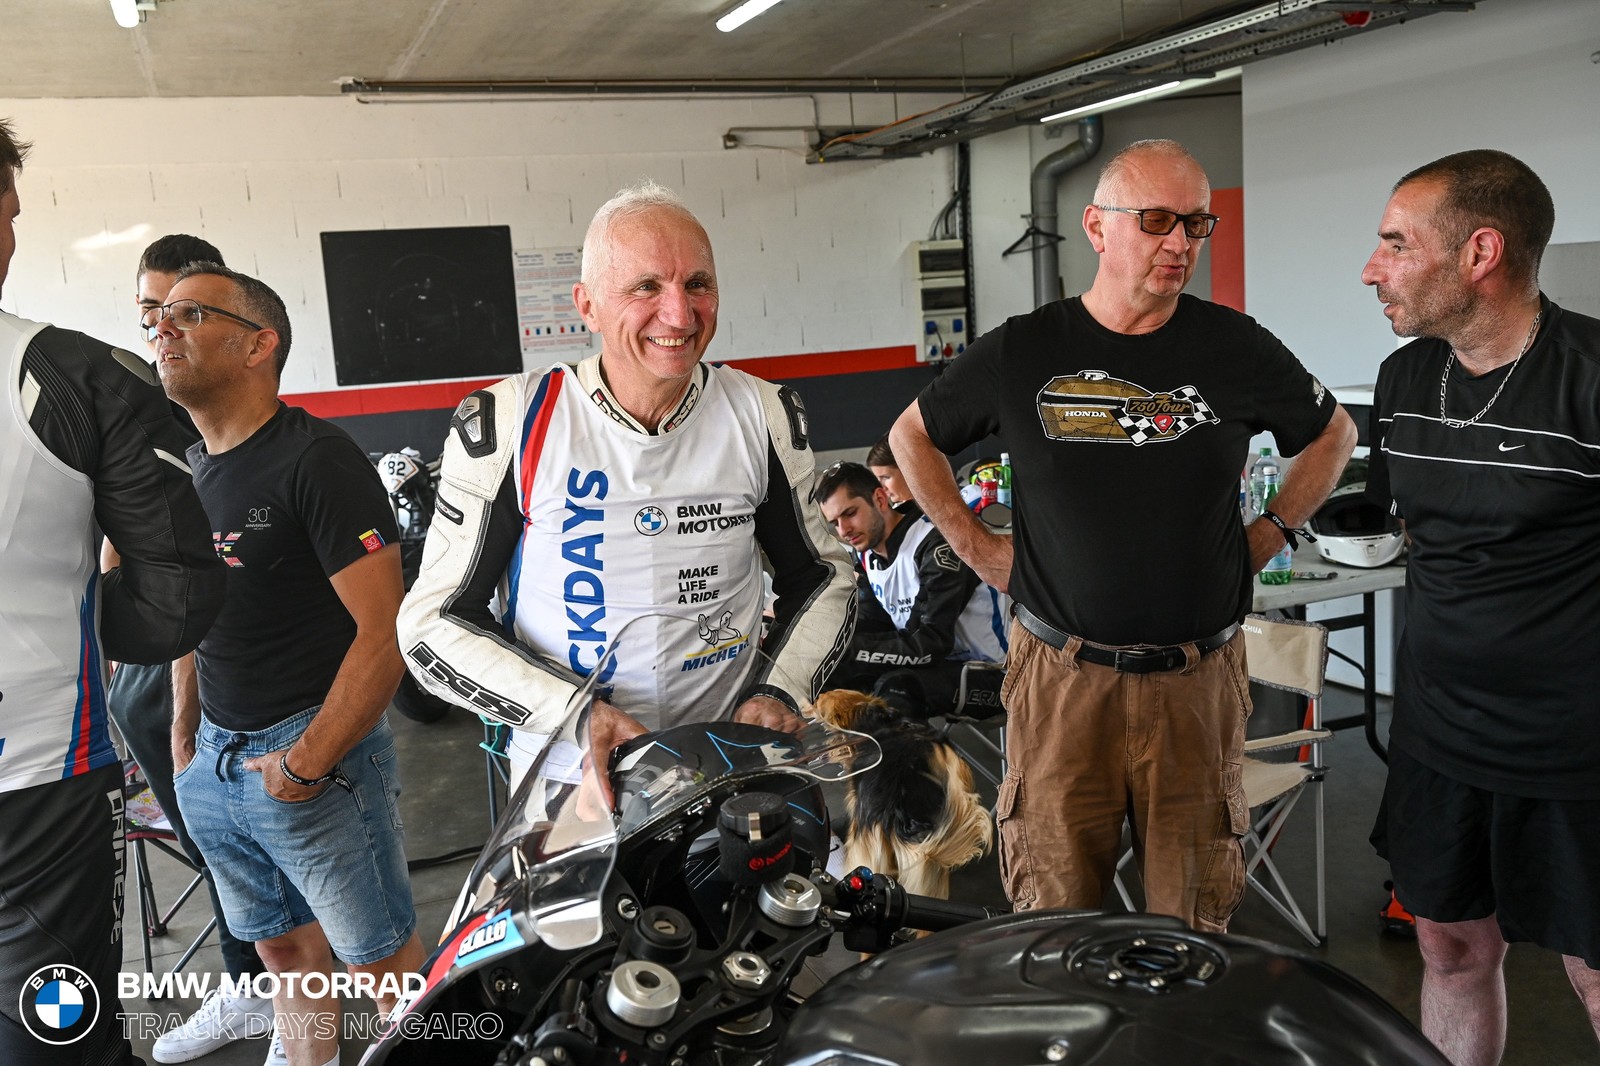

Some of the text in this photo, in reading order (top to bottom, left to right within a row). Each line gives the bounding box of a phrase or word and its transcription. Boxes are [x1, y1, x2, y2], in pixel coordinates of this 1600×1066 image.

[1065, 410, 1107, 418] HONDA
[387, 461, 405, 476] 82
[676, 503, 722, 518] BMW
[561, 467, 610, 681] CKDAYS
[678, 565, 719, 580] MAKE
[678, 580, 707, 592] LIFE
[678, 589, 720, 604] A RIDE
[855, 649, 932, 666] BERING
